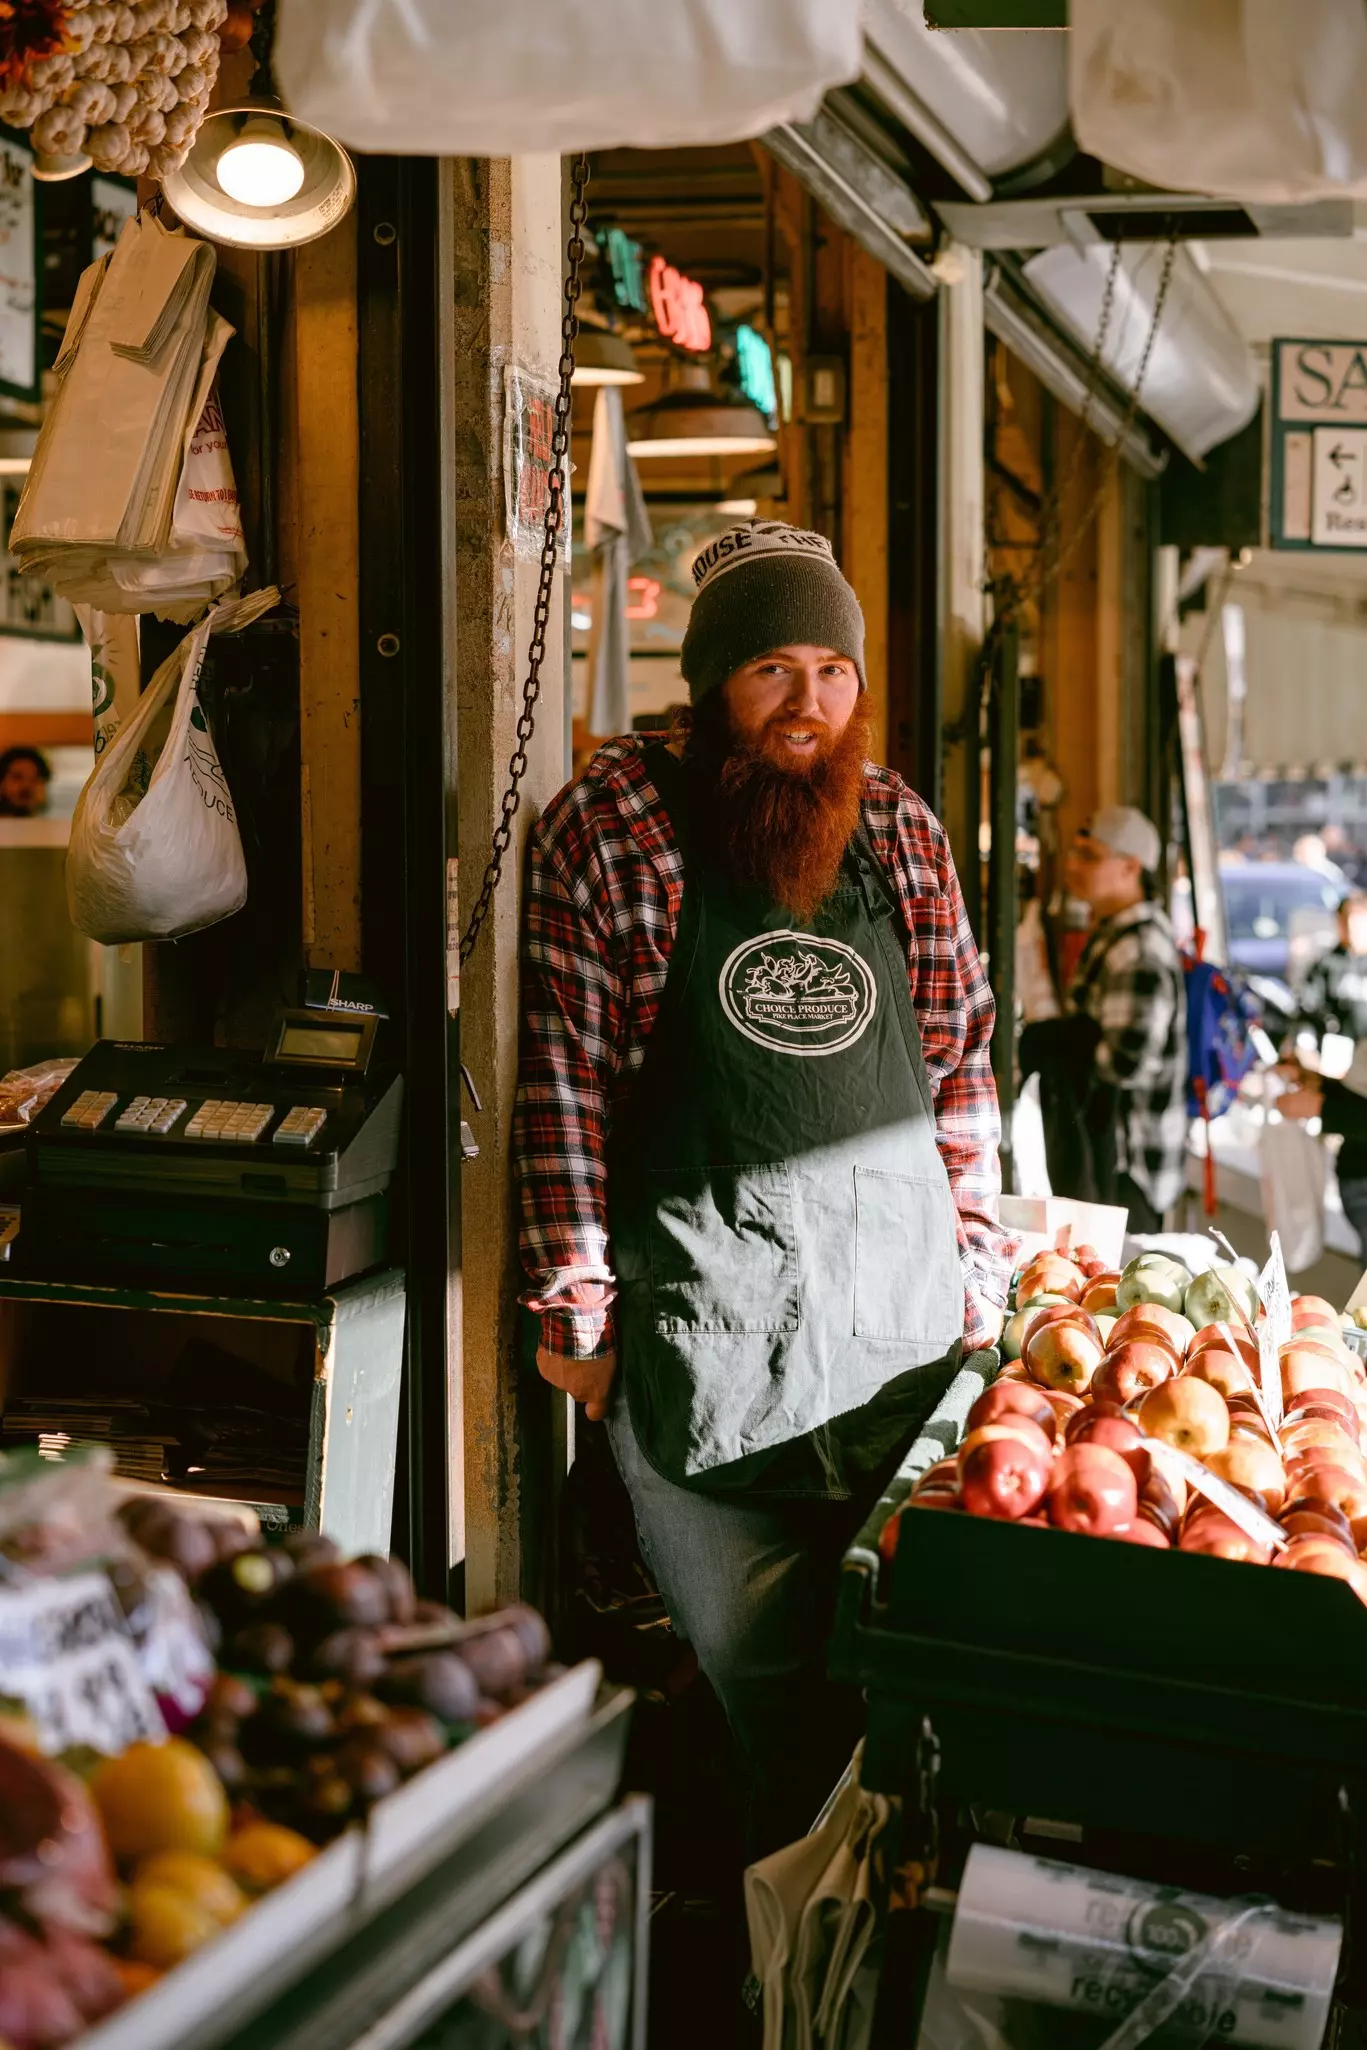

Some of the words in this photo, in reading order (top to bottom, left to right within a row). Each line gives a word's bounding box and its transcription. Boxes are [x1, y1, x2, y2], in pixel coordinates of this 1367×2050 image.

[329, 998, 374, 1011] SHARP
[755, 1003, 797, 1015] CHOICE
[799, 1004, 848, 1014] PRODUCE
[1069, 1976, 1236, 2033] recble
